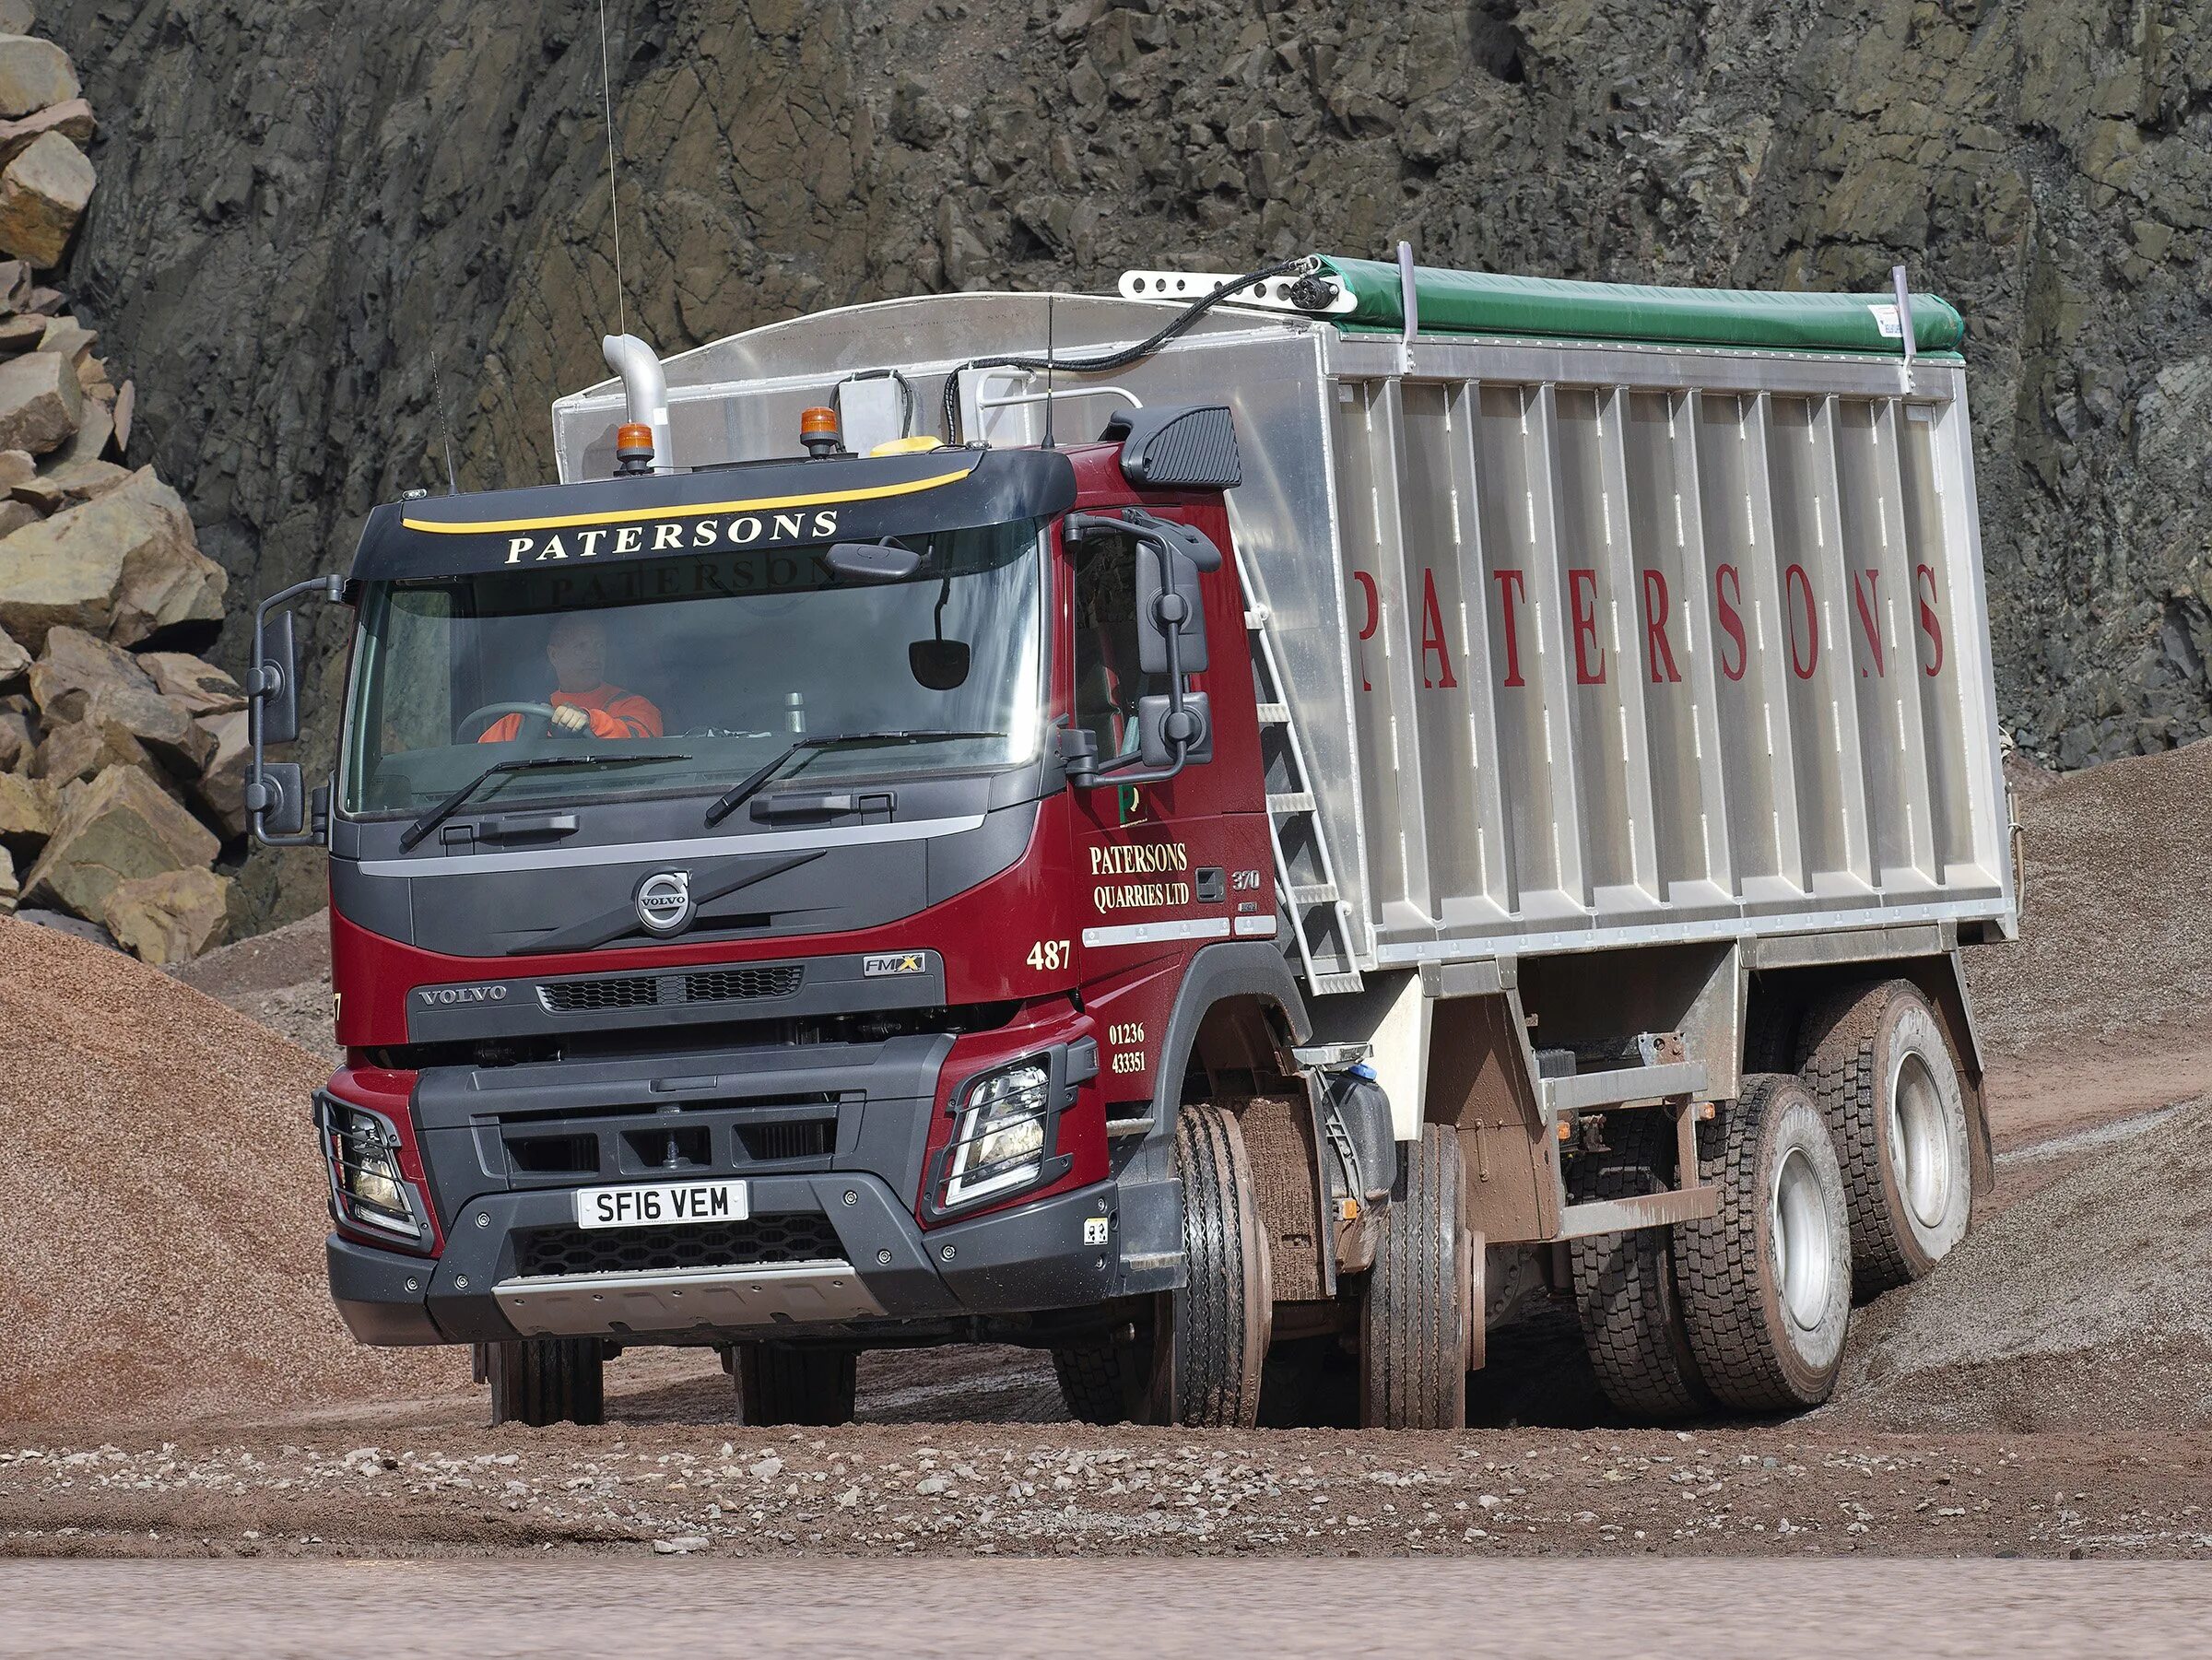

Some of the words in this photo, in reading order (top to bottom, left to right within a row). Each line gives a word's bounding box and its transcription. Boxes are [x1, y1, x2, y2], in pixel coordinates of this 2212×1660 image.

[504, 510, 839, 564] PATERSONS
[550, 555, 835, 607] PATERSON
[1354, 563, 1944, 692] PATERSONS
[1088, 842, 1188, 876] PATERSONS
[1231, 869, 1260, 891] 370
[641, 896, 686, 906] VOLVO
[1093, 883, 1164, 914] QUARRIES
[1164, 882, 1190, 905] LTD
[865, 954, 923, 972] FMX
[1026, 940, 1071, 971] 487
[418, 985, 507, 1006] VOLVO
[1109, 1022, 1145, 1045] 01236
[1112, 1051, 1146, 1074] 433351
[596, 1191, 662, 1222] SF16
[670, 1186, 729, 1218] VEM
